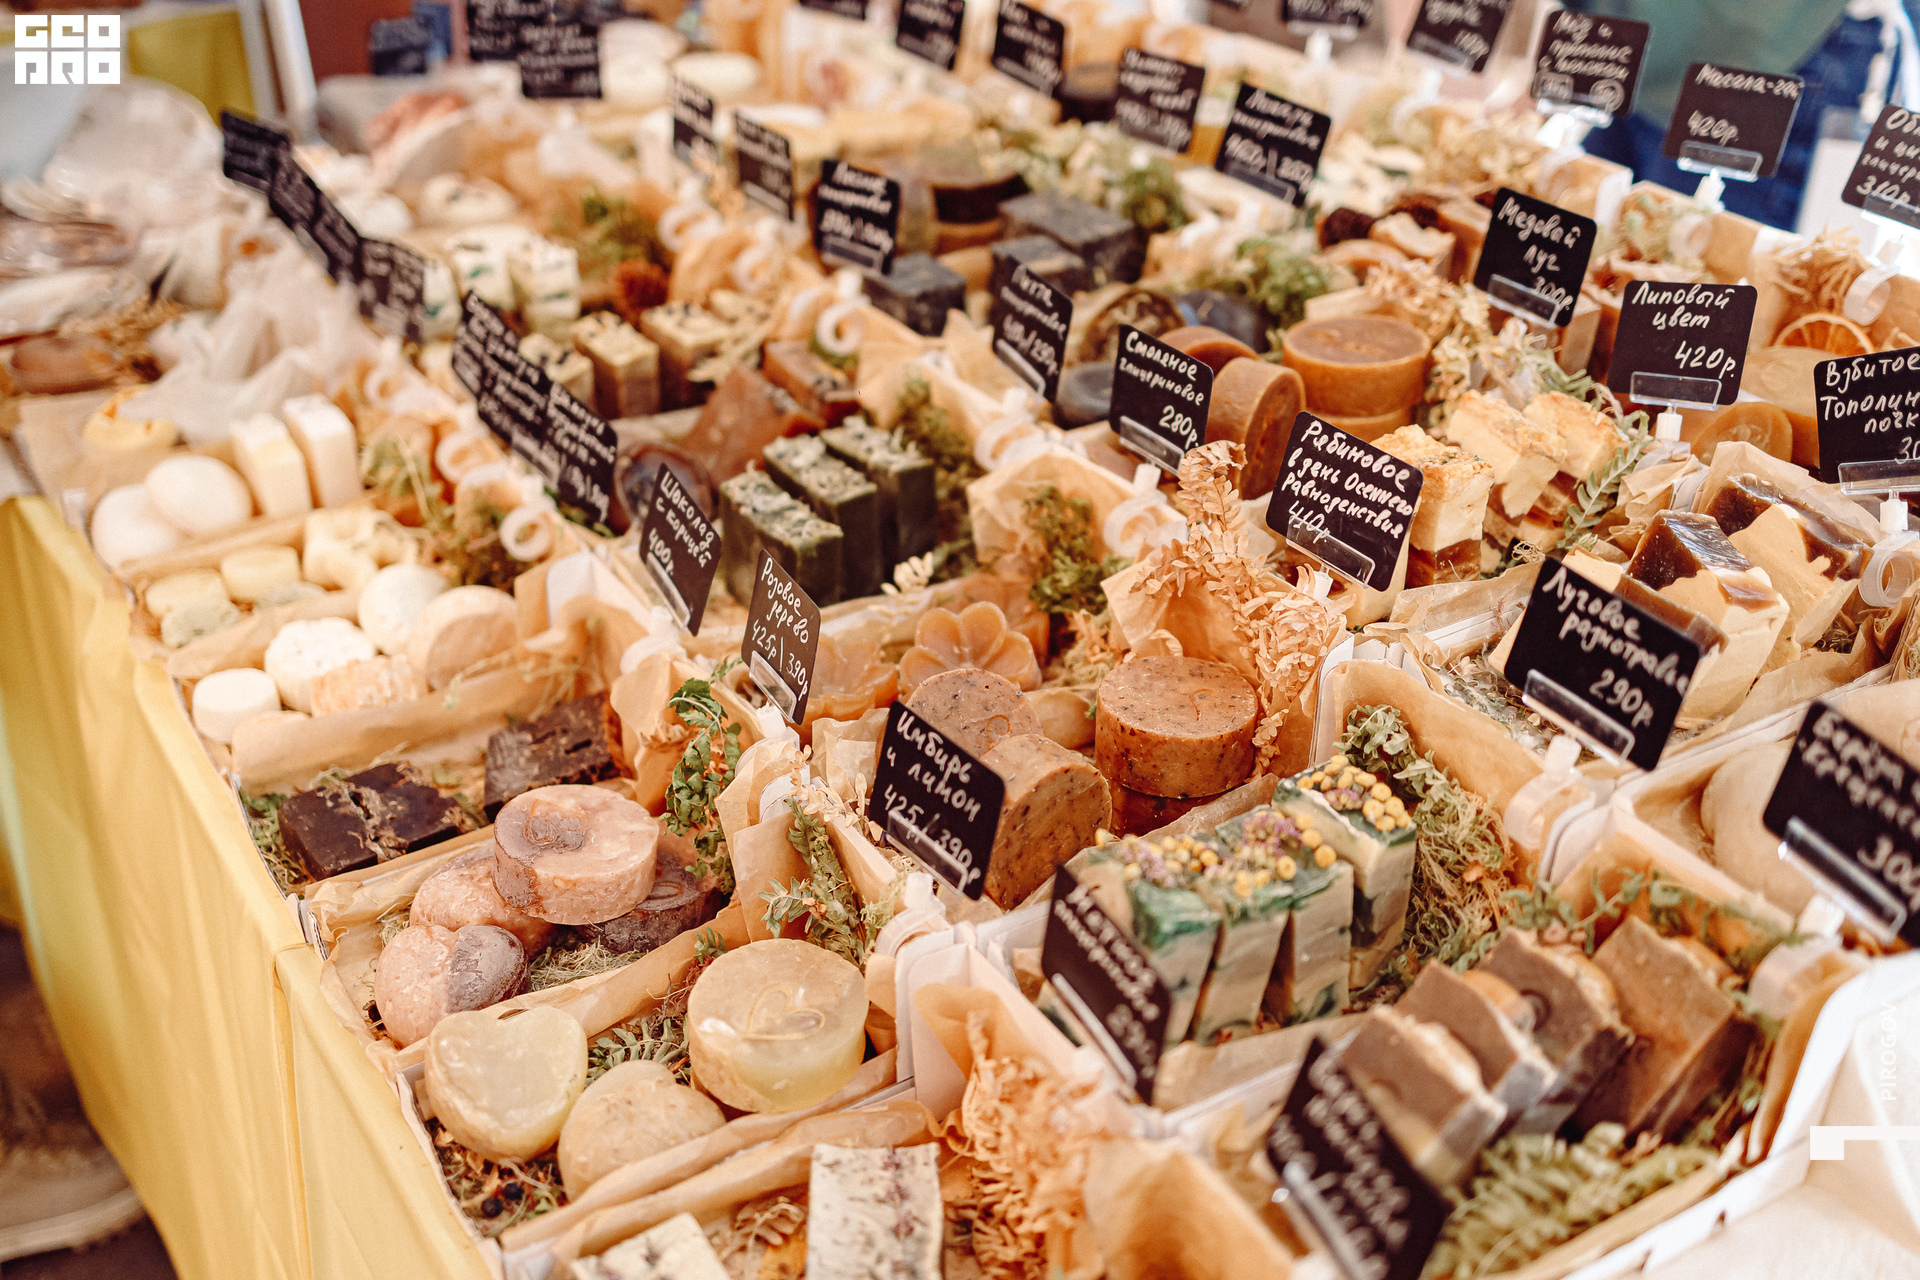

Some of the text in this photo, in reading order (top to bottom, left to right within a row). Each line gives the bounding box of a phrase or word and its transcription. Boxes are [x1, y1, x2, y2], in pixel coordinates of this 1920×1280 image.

[1874, 135, 1890, 151] и
[1631, 281, 1736, 310] Липовый
[1652, 304, 1711, 330] цвет
[1119, 357, 1205, 406] глицериновое
[1287, 447, 1413, 517] в день Осеннего
[1300, 419, 1411, 493] Рябиновое
[666, 508, 712, 568] корицей
[761, 557, 802, 618] Розовое
[1541, 565, 1641, 641] Луговое
[766, 599, 809, 644] дерево
[896, 710, 972, 784] Имбирь
[886, 746, 982, 823] и лимон
